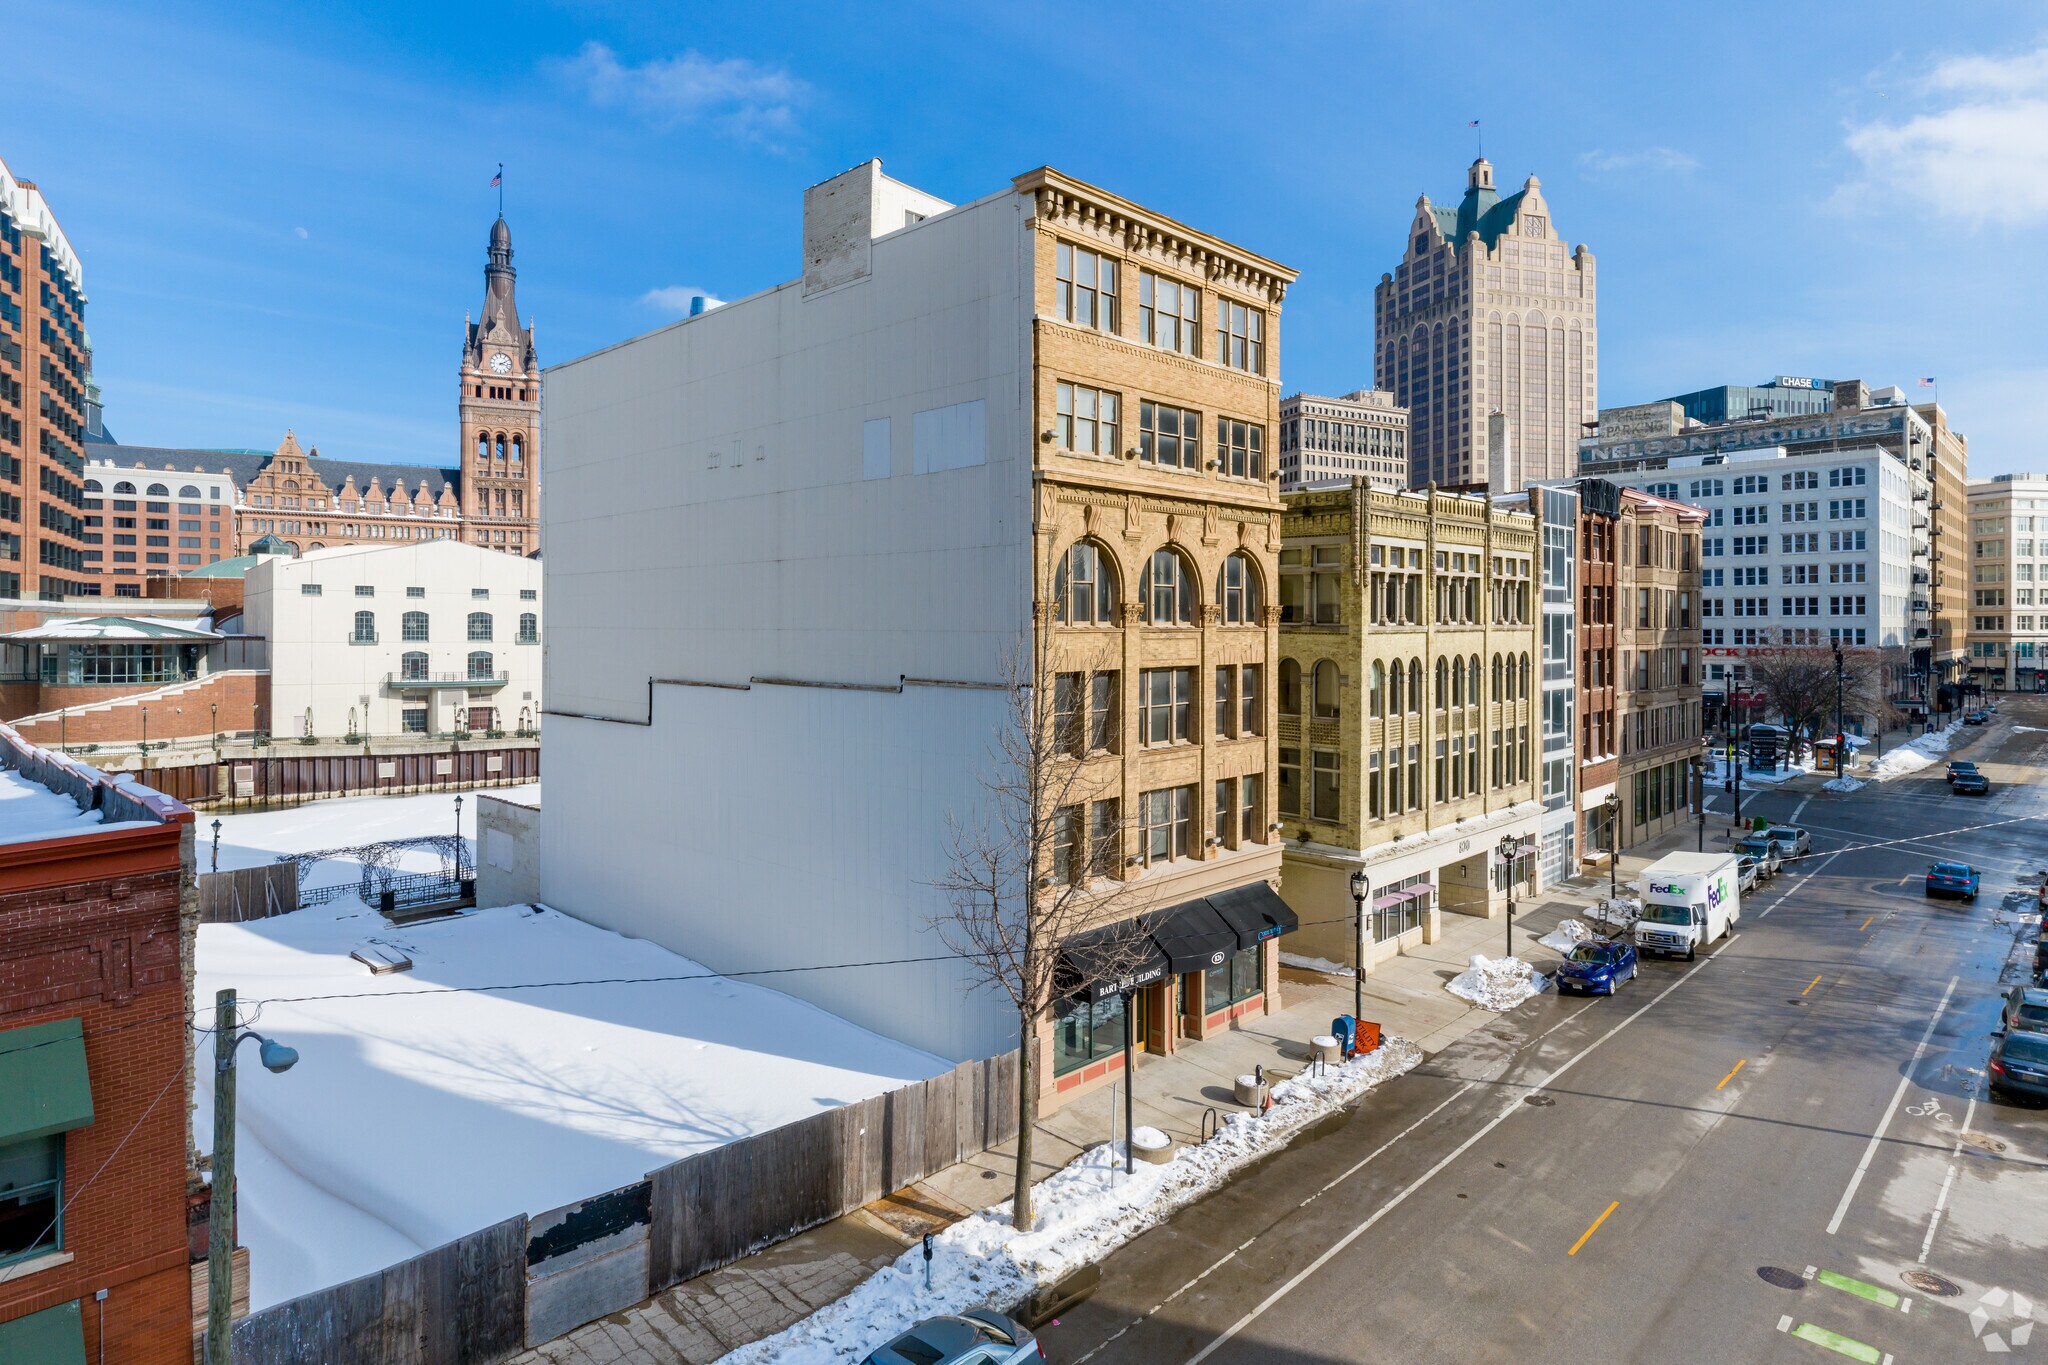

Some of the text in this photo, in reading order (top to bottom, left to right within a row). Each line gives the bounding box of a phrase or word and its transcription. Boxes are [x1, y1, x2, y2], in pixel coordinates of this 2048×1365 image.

[1782, 377, 1812, 388] CHASE
[1606, 420, 1664, 438] PARKING
[1591, 437, 1710, 461] NELSON
[1702, 647, 1740, 656] OCK
[1650, 883, 1686, 895] FedEx
[1707, 877, 1729, 911] FedEx
[1355, 1034, 1367, 1049] ORK
